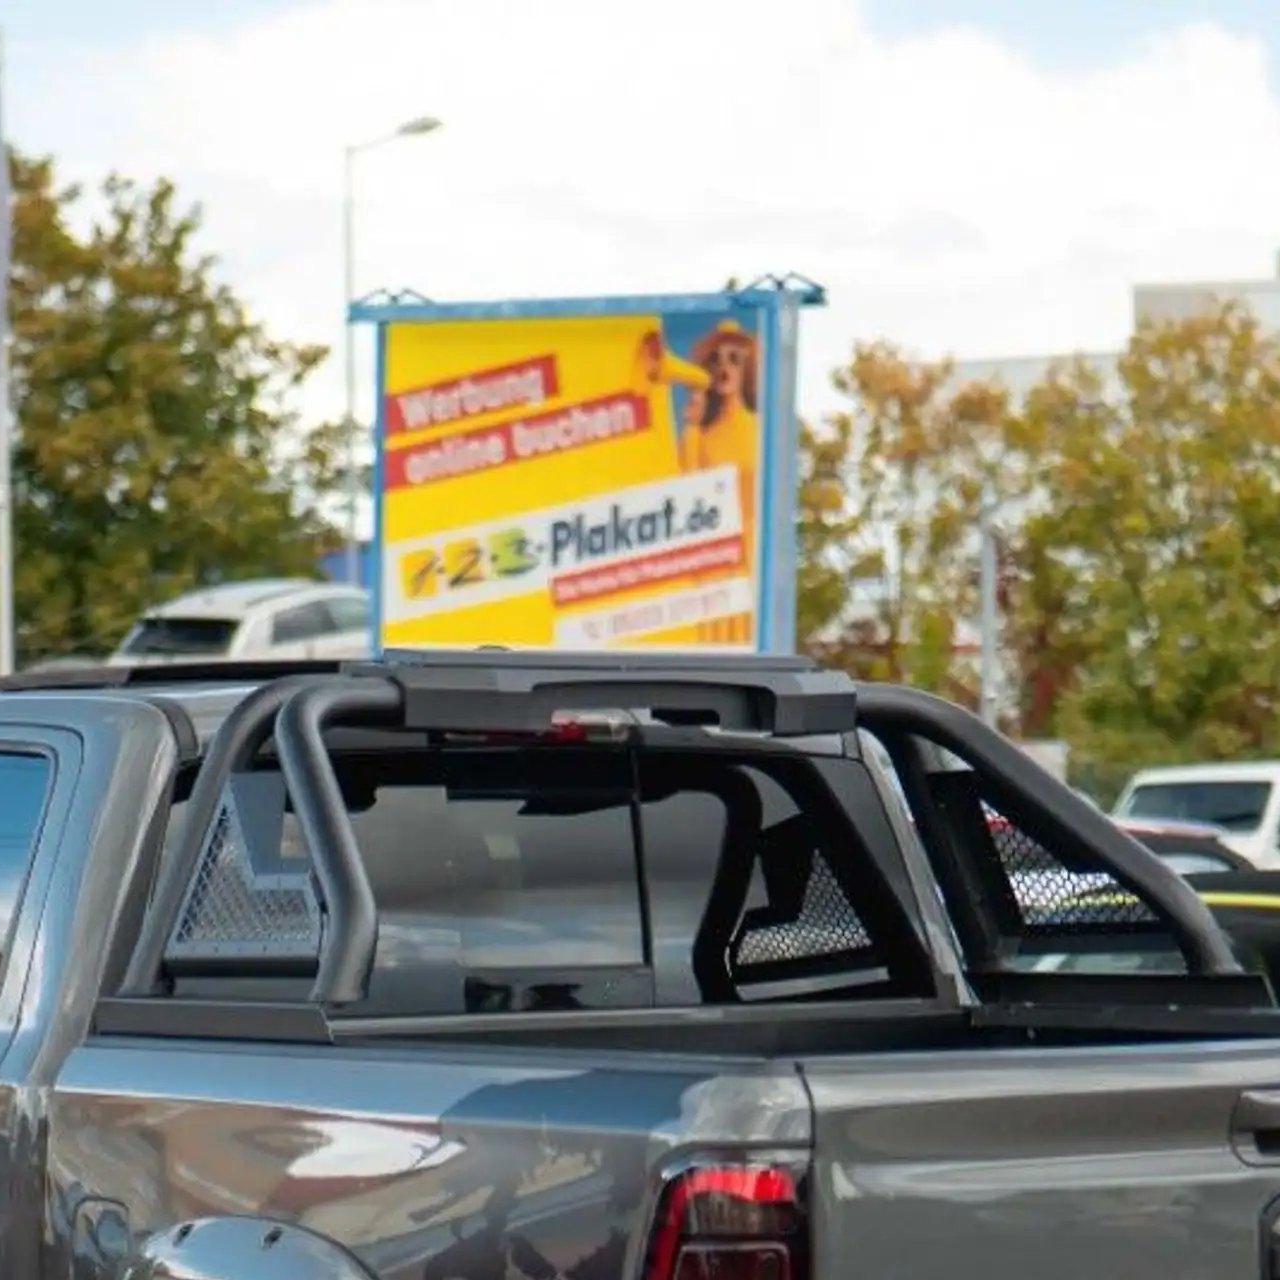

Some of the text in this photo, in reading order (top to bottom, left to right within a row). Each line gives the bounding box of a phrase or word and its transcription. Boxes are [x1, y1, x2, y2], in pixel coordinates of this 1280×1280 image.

[398, 367, 544, 429] Werbung
[404, 401, 636, 485] online buchen
